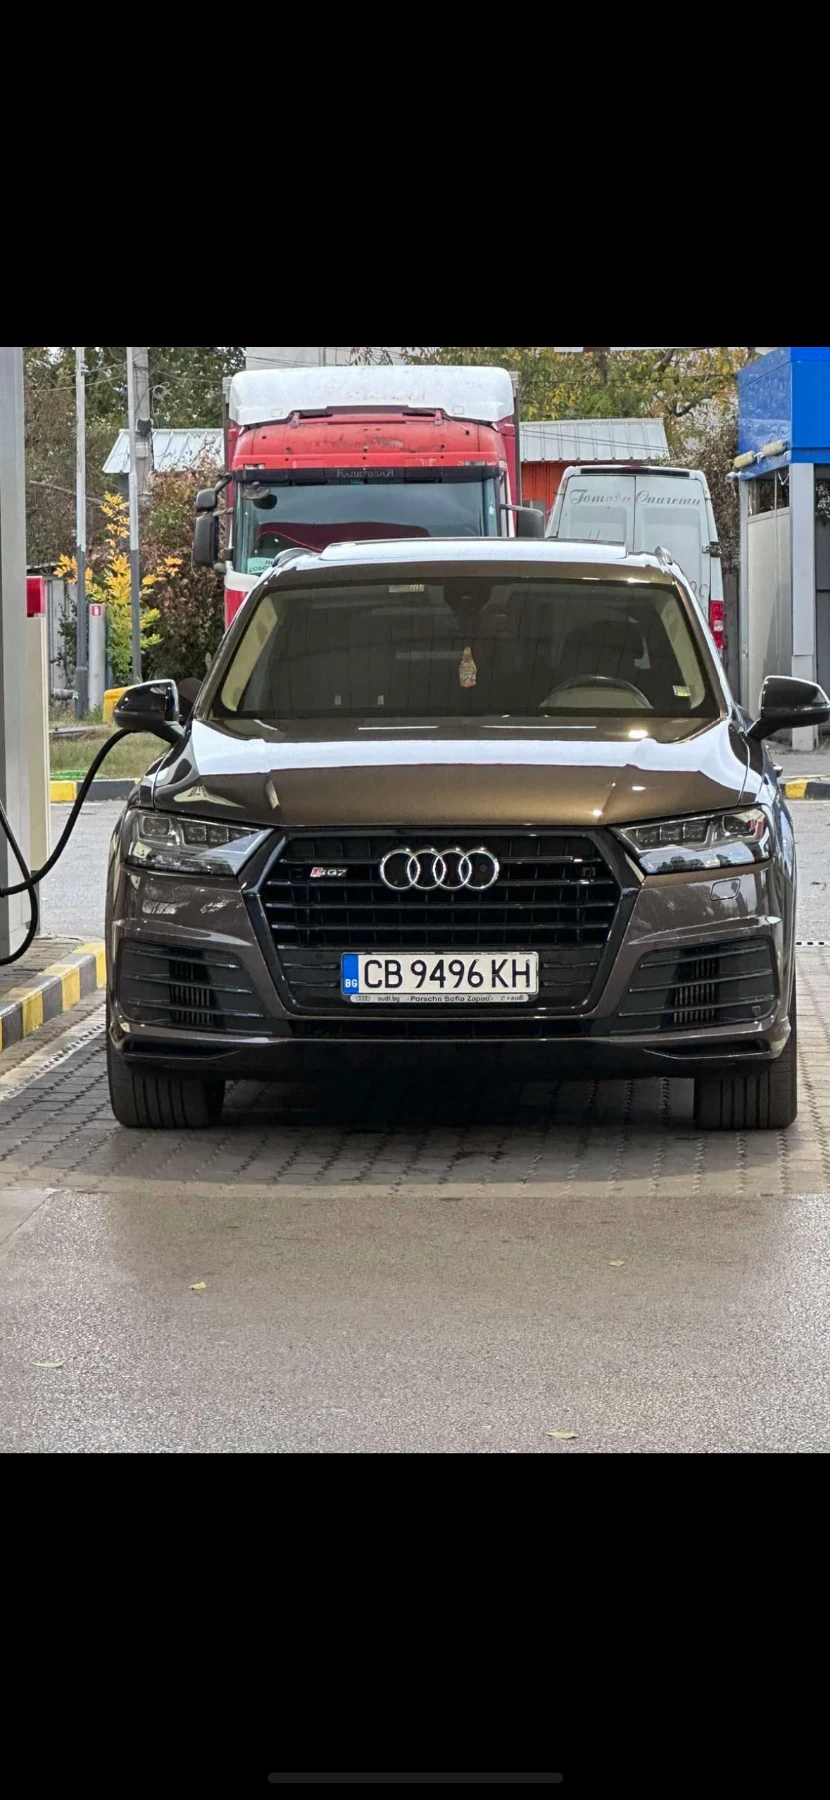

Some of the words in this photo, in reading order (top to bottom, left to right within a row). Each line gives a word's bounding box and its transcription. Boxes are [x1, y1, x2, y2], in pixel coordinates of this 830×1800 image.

[345, 978, 358, 988] BG
[364, 959, 403, 989] CB
[410, 959, 484, 989] 9496
[491, 959, 531, 988] KH
